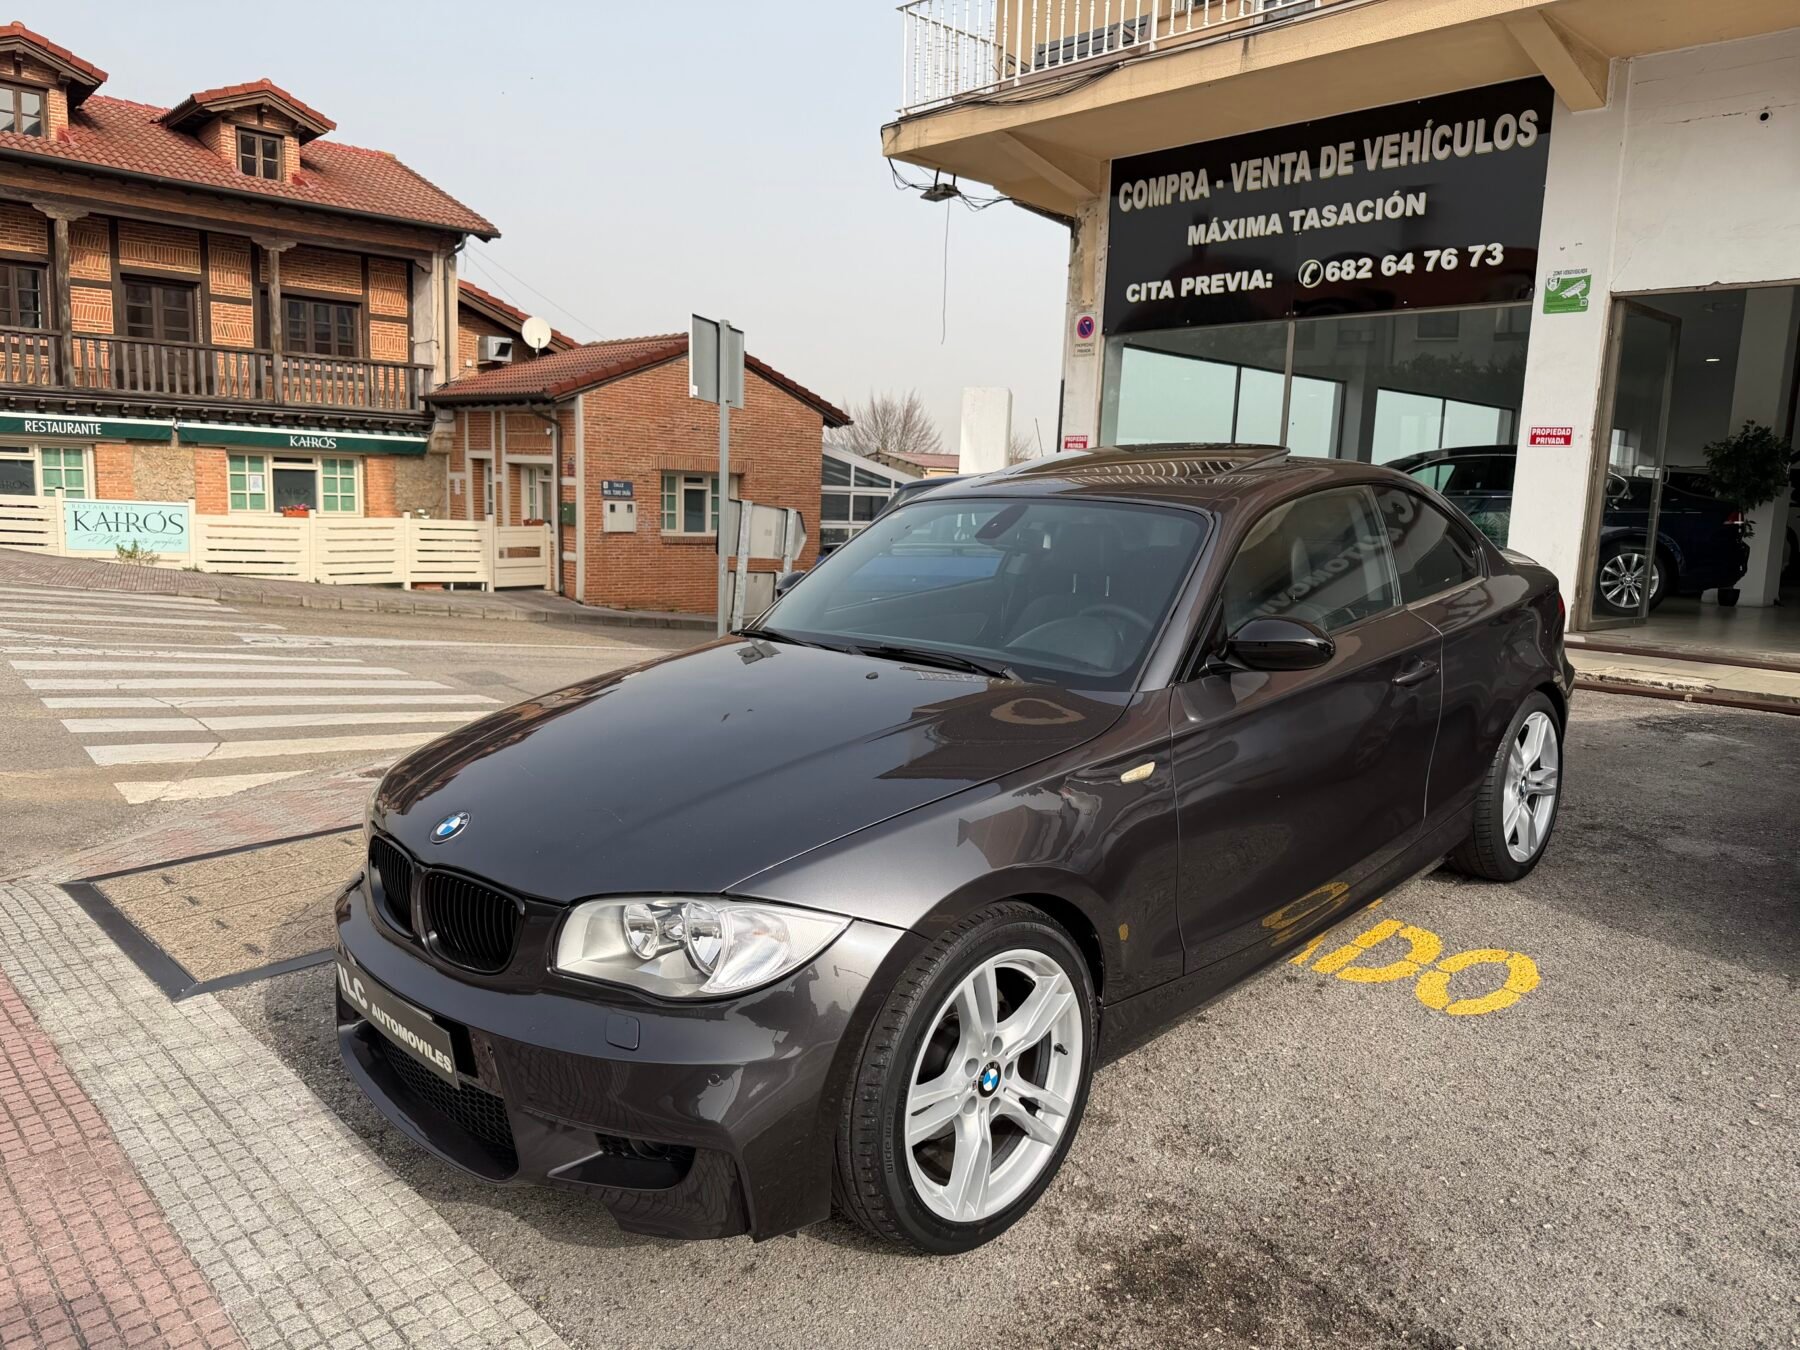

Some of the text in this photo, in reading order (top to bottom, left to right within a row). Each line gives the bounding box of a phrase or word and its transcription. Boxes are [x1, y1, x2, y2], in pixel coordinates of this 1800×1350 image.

[1118, 168, 1210, 212] COMPRA
[1230, 150, 1312, 193] VENTA
[1319, 141, 1355, 179] DE
[1363, 109, 1539, 172] VEHÍCULOS
[1187, 190, 1427, 246] MÁXIMA TASACIÓN
[1126, 242, 1504, 303] CITA PREVIA: 682 64 76 73
[24, 420, 102, 435] RESTAURANTE
[1531, 428, 1571, 436] PROPIEDAD
[1535, 437, 1565, 445] PRIVADA
[371, 1002, 452, 1074] AUTOMOVILES
